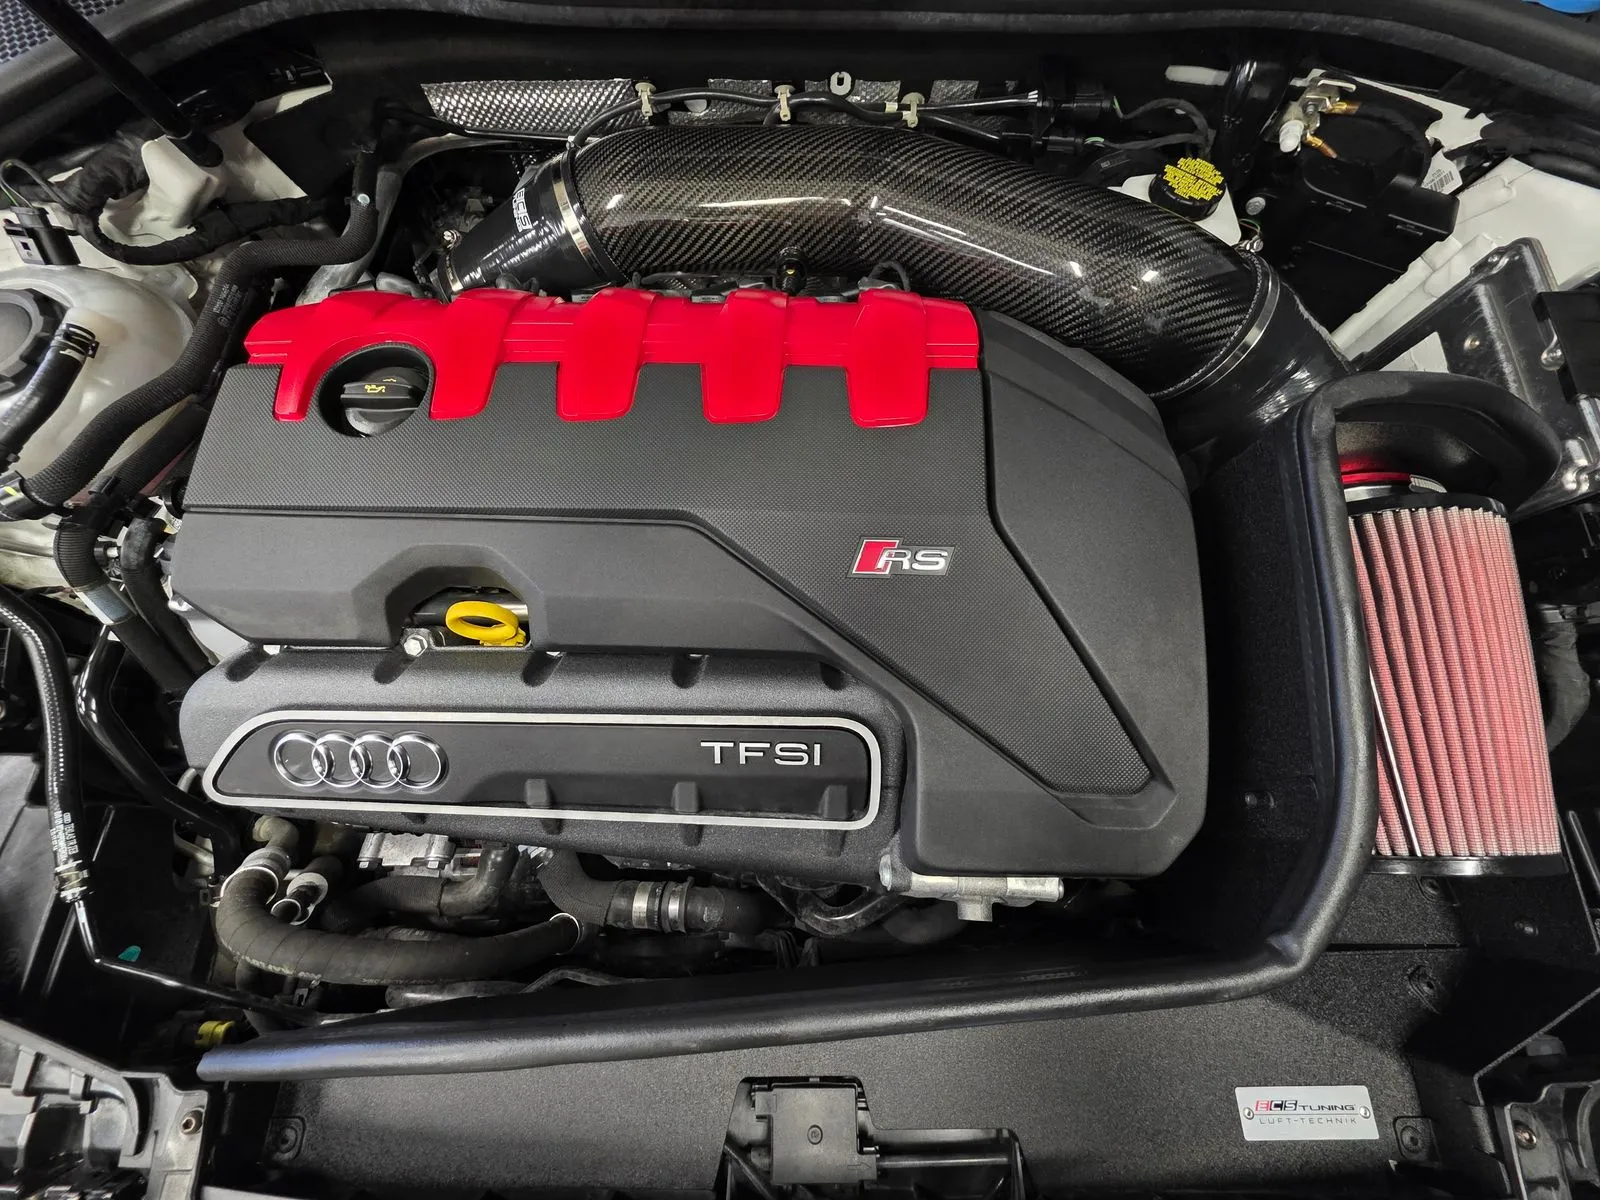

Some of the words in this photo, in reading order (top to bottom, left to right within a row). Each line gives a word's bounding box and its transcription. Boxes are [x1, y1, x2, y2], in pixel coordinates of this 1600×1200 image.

[862, 544, 949, 572] RS
[700, 741, 821, 766] TFSI
[1255, 1100, 1298, 1111] ECS
[1259, 1117, 1358, 1125] LUFT-TECHNIK
